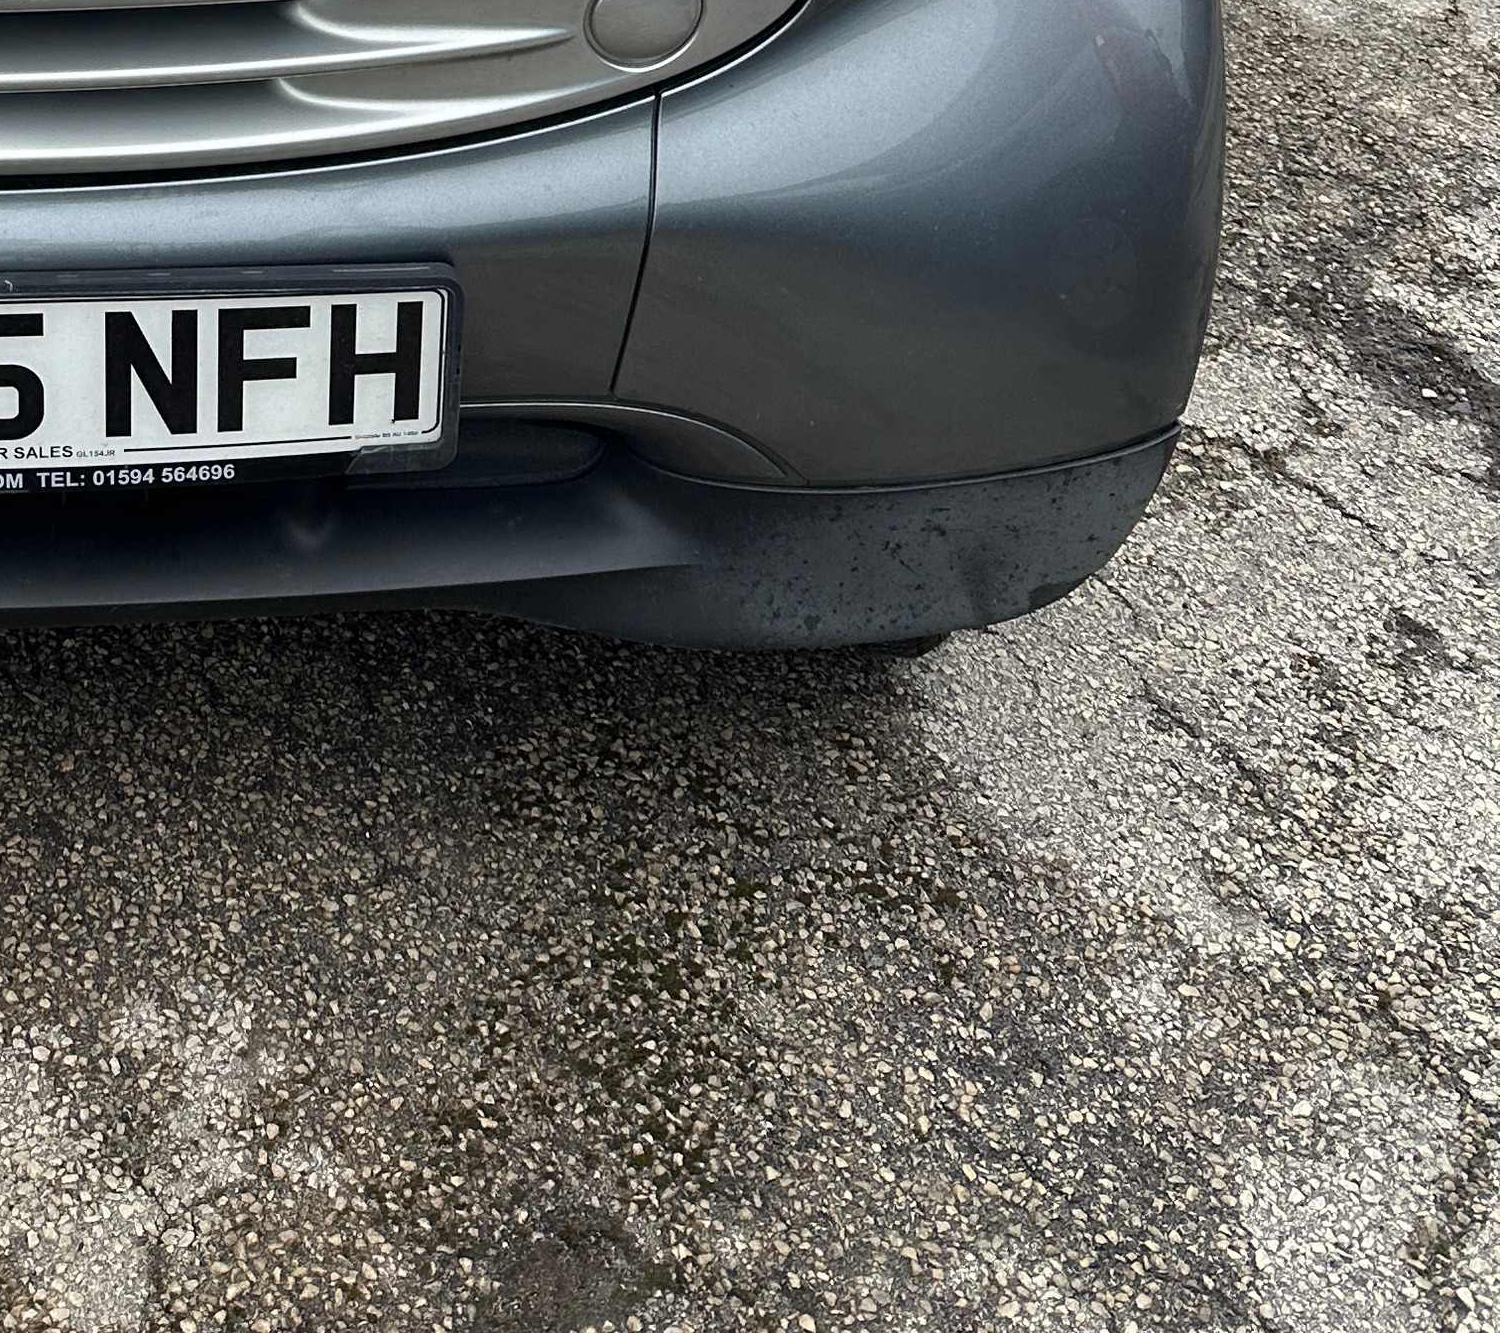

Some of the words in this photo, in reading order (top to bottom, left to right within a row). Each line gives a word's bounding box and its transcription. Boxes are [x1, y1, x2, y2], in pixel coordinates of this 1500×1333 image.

[104, 300, 424, 438] NFH
[13, 445, 74, 460] SALES
[36, 471, 86, 489] TEL:
[92, 467, 156, 487] 01594
[161, 463, 236, 484] 564696
